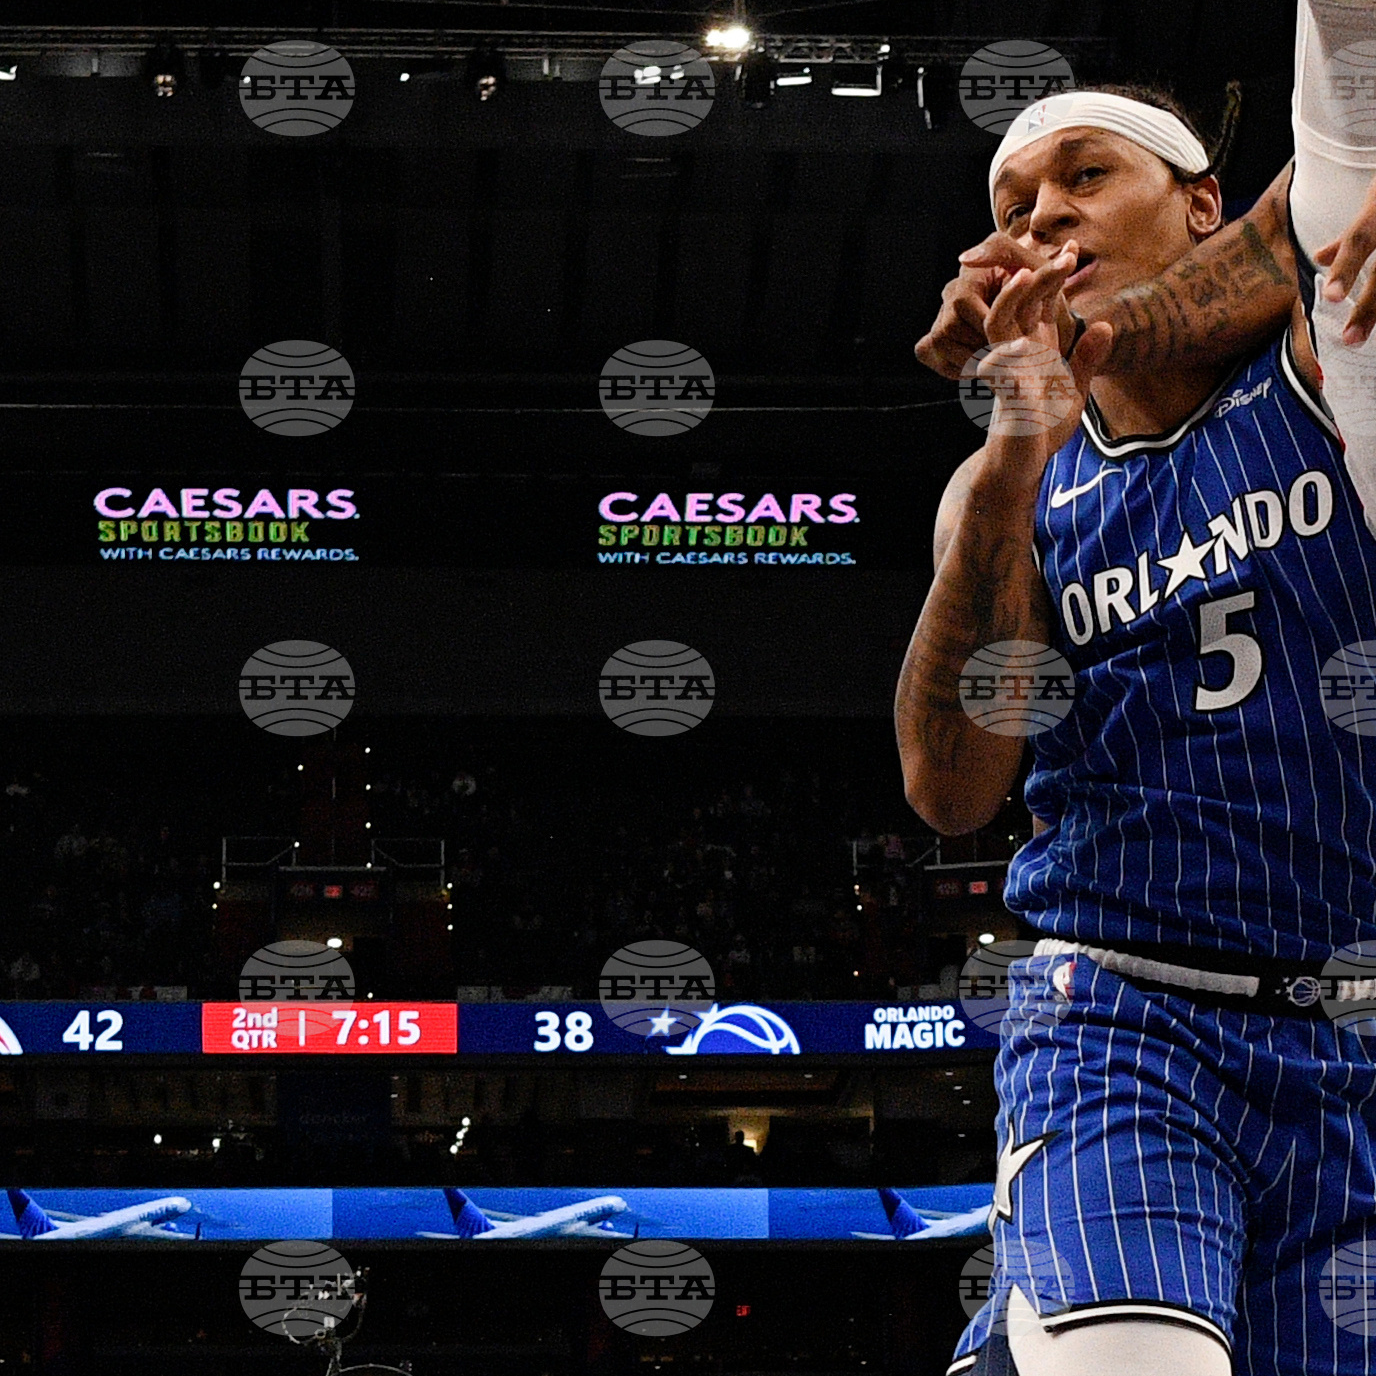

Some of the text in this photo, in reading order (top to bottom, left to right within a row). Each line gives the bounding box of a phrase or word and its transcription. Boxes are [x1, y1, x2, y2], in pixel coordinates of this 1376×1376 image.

[97, 520, 310, 543] SPORTSBOOK
[598, 524, 810, 547] SPORTSBOOK
[100, 547, 153, 561] WITH
[158, 547, 252, 561] CAESARS
[598, 551, 650, 565] WITH
[655, 551, 749, 565] CAESARS
[1195, 591, 1263, 711] 5
[231, 1007, 279, 1030] 2nd
[873, 1004, 956, 1023] ORLANDO
[62, 1009, 124, 1051] 42
[331, 1010, 422, 1046] 7:15
[533, 1011, 594, 1052] 38
[864, 1020, 966, 1050] MAGIC
[230, 1029, 278, 1051] QTR
